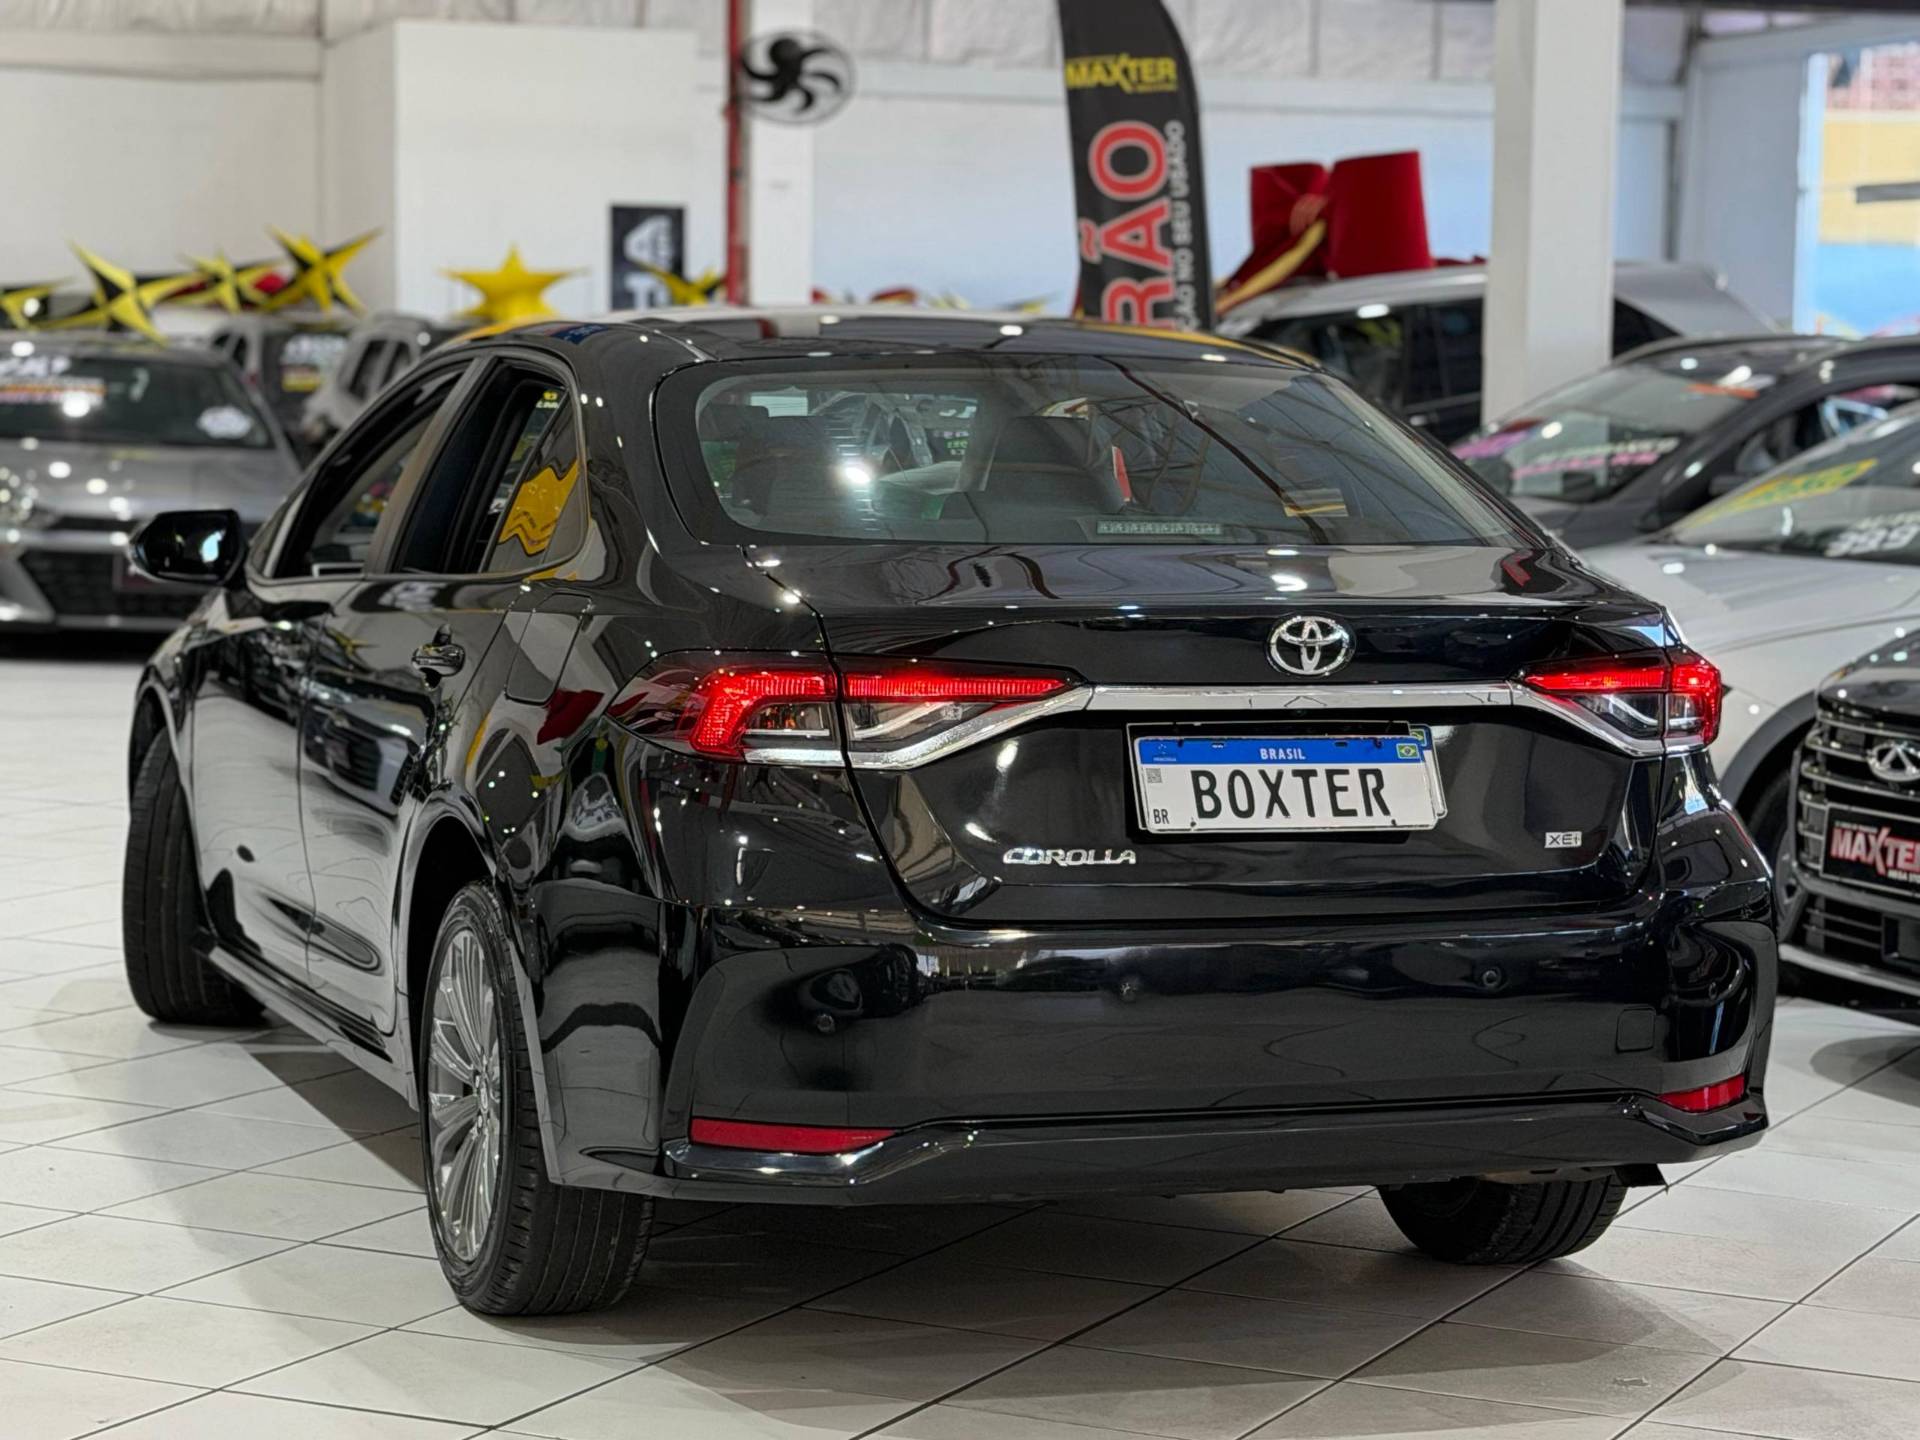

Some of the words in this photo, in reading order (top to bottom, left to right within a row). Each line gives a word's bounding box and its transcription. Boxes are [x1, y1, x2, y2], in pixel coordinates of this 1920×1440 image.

[1064, 53, 1177, 93] MAXTER
[1172, 201, 1193, 245] SEU
[1259, 747, 1306, 760] BRASIL
[1190, 768, 1391, 820] BOXTER
[1153, 808, 1170, 825] BR
[1003, 847, 1136, 866] COROLLA
